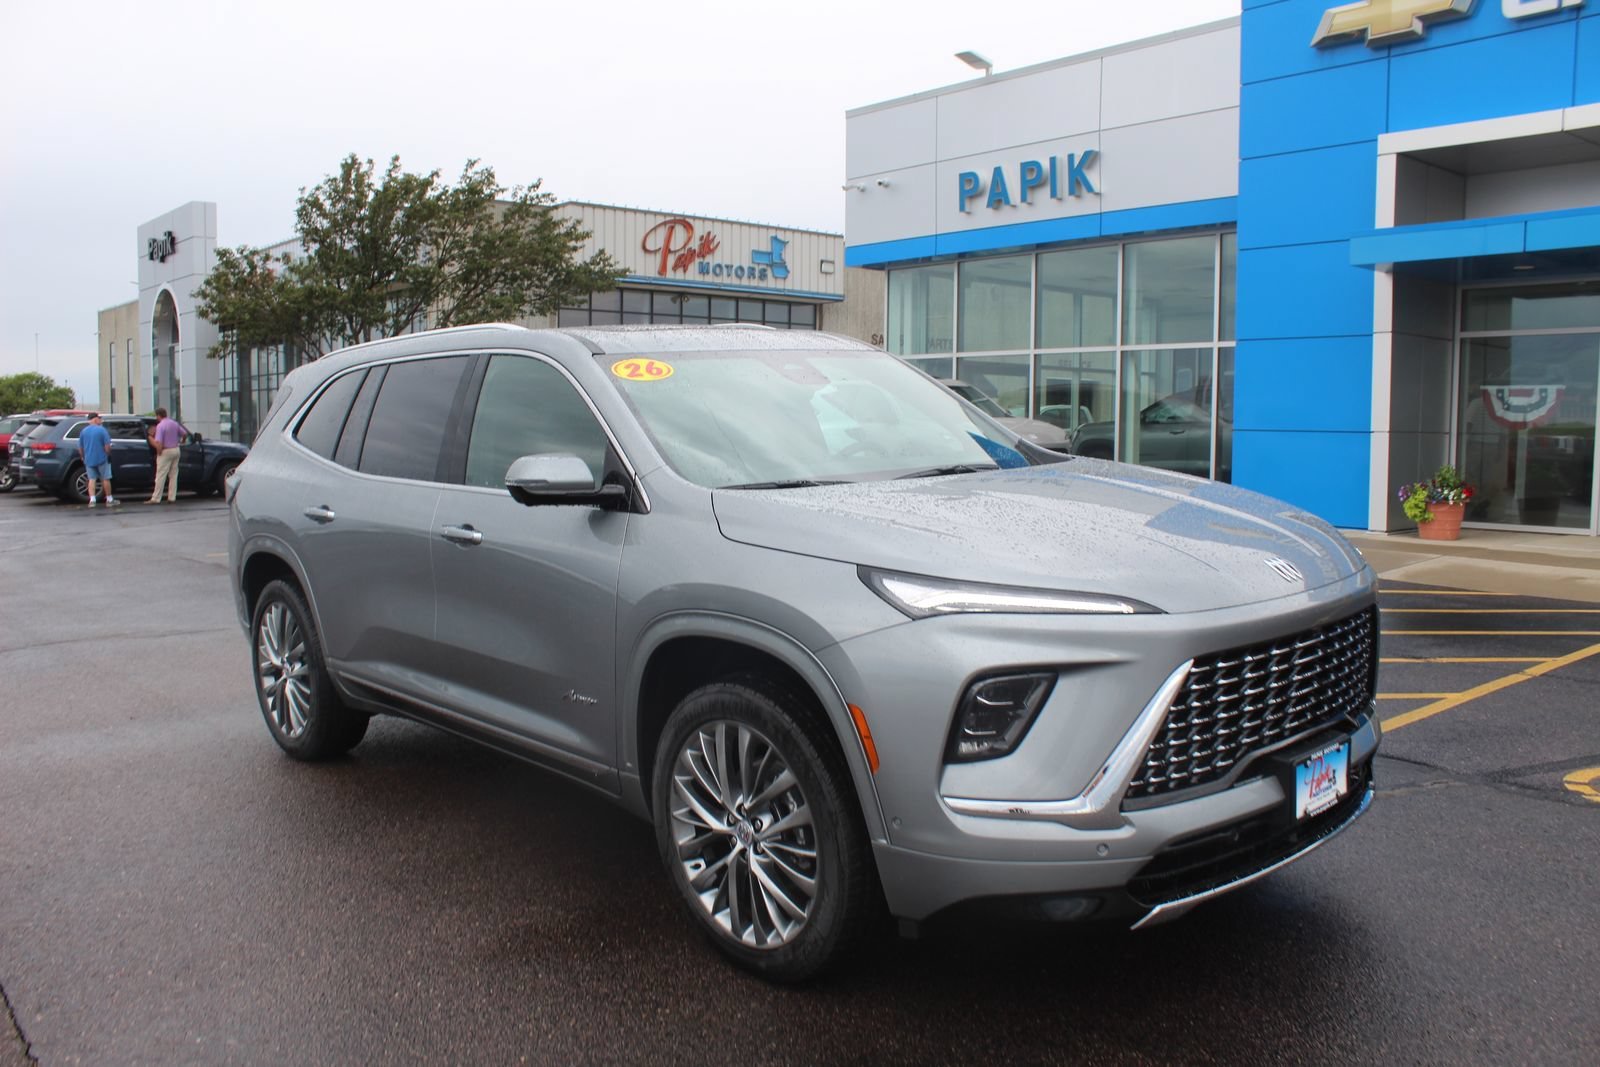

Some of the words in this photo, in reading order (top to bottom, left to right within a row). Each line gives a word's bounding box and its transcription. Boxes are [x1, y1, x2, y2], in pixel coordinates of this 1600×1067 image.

[958, 149, 1099, 214] PAPIK
[148, 231, 176, 263] Papik
[641, 218, 721, 276] Papik
[698, 260, 768, 281] MOTORS
[623, 361, 663, 378] 26
